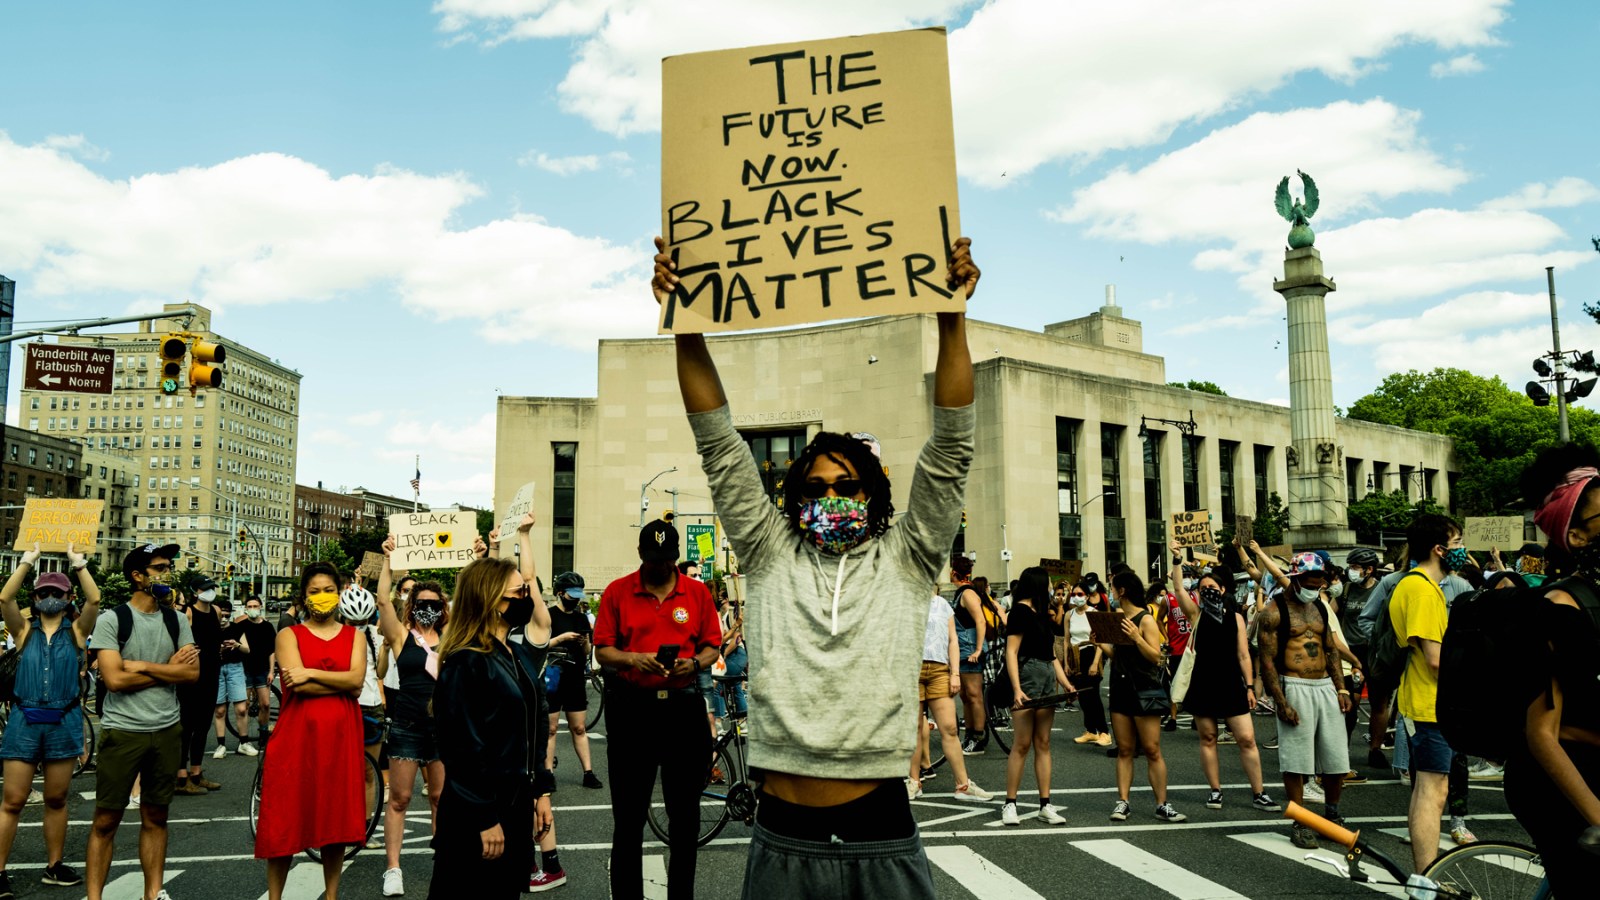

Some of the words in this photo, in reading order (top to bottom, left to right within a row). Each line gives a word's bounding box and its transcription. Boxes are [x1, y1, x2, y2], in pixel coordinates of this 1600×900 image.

[749, 49, 882, 105] THE
[722, 102, 886, 146] FUTURE
[787, 131, 823, 148] IS
[741, 147, 848, 186] NOW.
[668, 188, 864, 247] BLACK
[671, 220, 894, 275] LIVES
[31, 347, 88, 361] Vanderbilt
[91, 352, 111, 363] Ave
[35, 360, 82, 373] Flatbush
[85, 364, 105, 374] Ave
[69, 377, 101, 388] NORTH
[790, 409, 822, 420] LIBRARY
[29, 510, 98, 525] BREONNA
[409, 514, 459, 526] BLACK
[1174, 512, 1194, 524] NO
[1485, 518, 1504, 527] SAY
[1174, 522, 1210, 535] RACIST
[1481, 527, 1510, 535] THEIR
[25, 527, 92, 546] TAYLOR
[396, 533, 435, 549] LIVES
[1480, 534, 1511, 543] NAMES
[406, 548, 476, 563] MATTER
